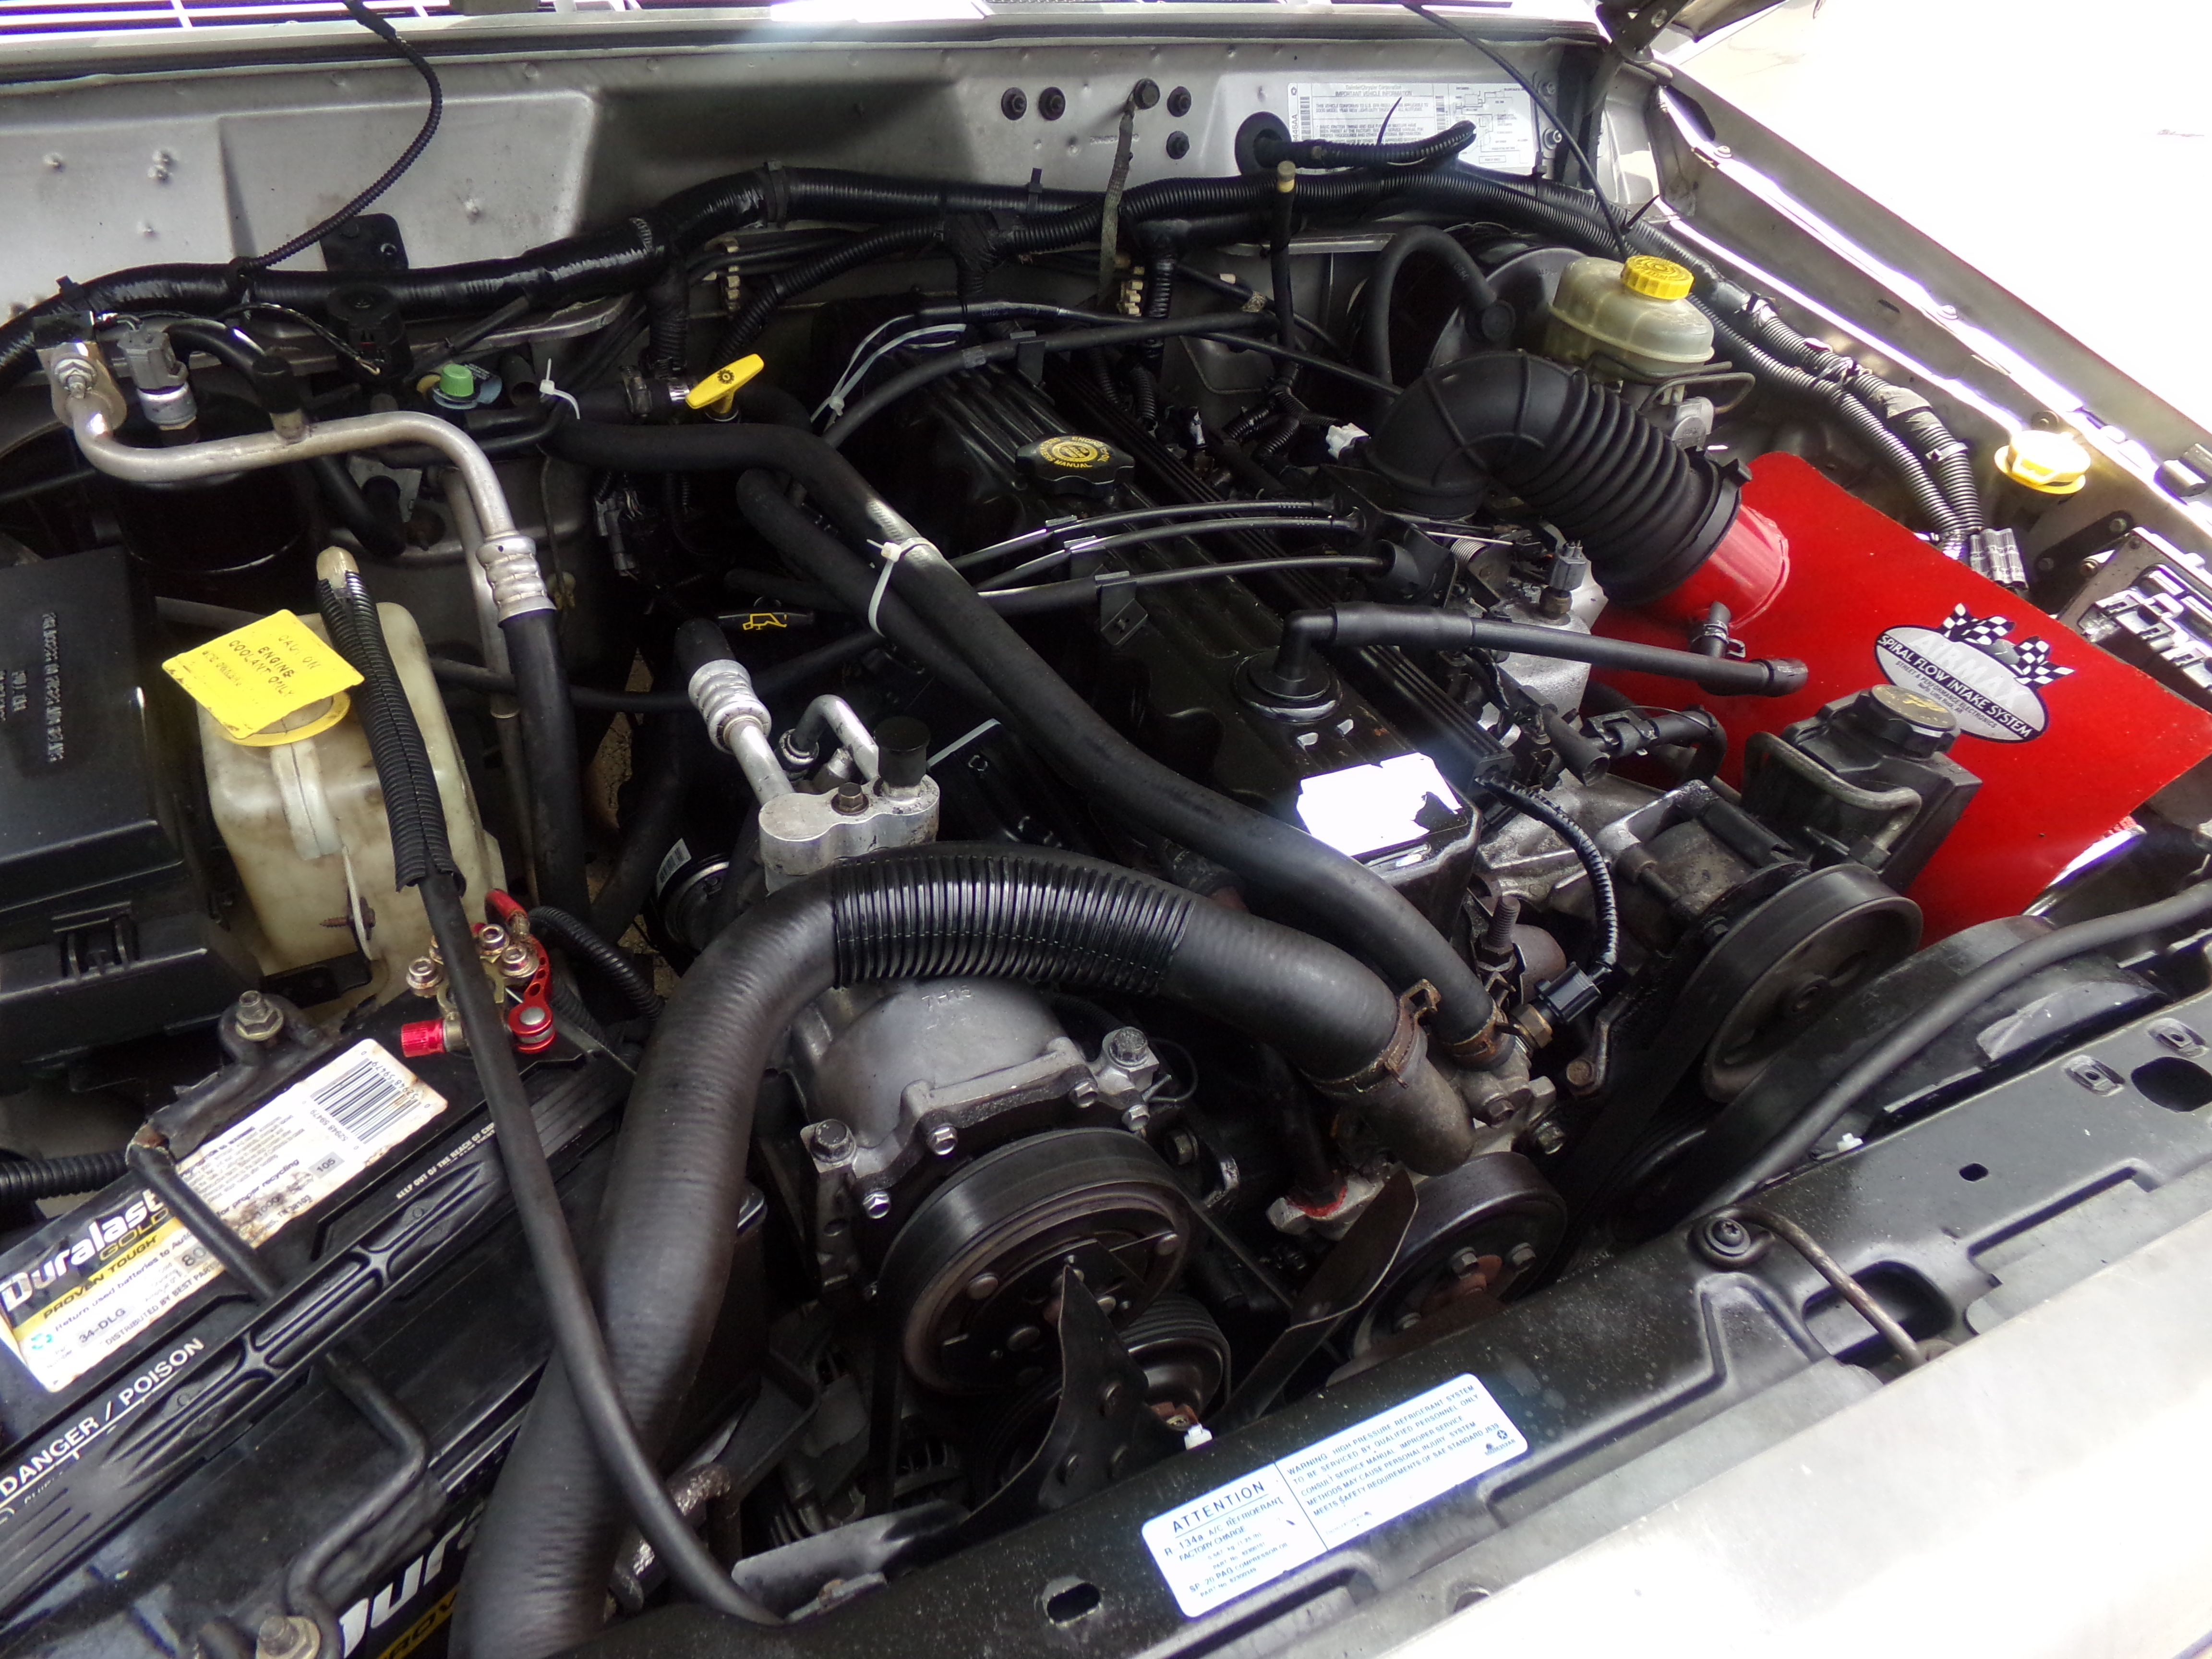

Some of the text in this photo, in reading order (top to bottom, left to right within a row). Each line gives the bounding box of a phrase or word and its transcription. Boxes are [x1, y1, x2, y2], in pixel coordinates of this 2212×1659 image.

[1054, 459, 1093, 468] MANUAL
[1071, 436, 1104, 448] ENGINE
[228, 639, 272, 677] COOLANT
[268, 675, 294, 697] ONLY
[257, 646, 298, 678] ENGINE
[1877, 635, 1915, 662] SPIRAL
[1913, 657, 1948, 681] FLOW
[1946, 679, 1990, 709] INTAKE
[1986, 702, 2032, 738] SYSTEM
[1895, 661, 1917, 674] STREET
[1920, 676, 1960, 705] PERFORMANCE
[1959, 701, 1997, 729] ELECTRONICS
[413, 1173, 428, 1186] OUT
[427, 1166, 437, 1177] OF
[436, 1155, 452, 1168] THE
[449, 1139, 472, 1159] REACH
[0, 1189, 162, 1312] Duralast
[55, 1307, 89, 1332] Return
[92, 1287, 115, 1307] used
[117, 1257, 159, 1289] batteries
[159, 1249, 170, 1258] to
[232, 1186, 260, 1210] proper
[262, 1159, 300, 1187] recycling
[79, 1308, 126, 1343] 34-DLG
[181, 1243, 210, 1267] 80
[316, 1158, 336, 1172] 105
[97, 1205, 170, 1262] GOLD
[41, 1269, 109, 1320] PROVEN
[108, 1234, 157, 1273] TOUGH
[105, 1305, 159, 1346] DISTRIBUTED
[159, 1294, 171, 1307] BY
[171, 1278, 192, 1297] BEST
[193, 1258, 222, 1281] PART
[0, 1416, 100, 1497] DANGER
[105, 1400, 112, 1422] /
[118, 1337, 206, 1407] POISON
[1293, 1394, 1479, 1485] TO BE SERVICED BY QUALIFIED PERSONNEL ONLY
[1332, 1443, 1352, 1455] HIGH
[1352, 1424, 1391, 1445] PRESSURE
[1394, 1399, 1443, 1426] REFRIGERANT
[1446, 1384, 1475, 1402] SYSTEM
[1301, 1476, 1334, 1496] CONSULT
[1335, 1462, 1364, 1479] SERVICE
[1399, 1429, 1435, 1449] IMPROPER
[1435, 1416, 1463, 1432] SERVICE
[1306, 1421, 1476, 1506] METHODS MAY CAUSE PERSONAL INJURY SYSTEM
[1313, 1501, 1338, 1516] MEETS
[1338, 1486, 1366, 1504] SAFETY
[1367, 1460, 1421, 1490] REQUIREMENTS
[1420, 1454, 1433, 1464] OF
[1432, 1448, 1446, 1458] SAE
[1447, 1430, 1484, 1451] STANDARD
[1173, 1481, 1265, 1533] ATTENTION
[1209, 1525, 1223, 1536] A/C
[1226, 1496, 1283, 1527] REFRIGERANT
[1179, 1526, 1244, 1561] FACTORY CHARGE
[1235, 1547, 1278, 1570] COMPRESSOR
